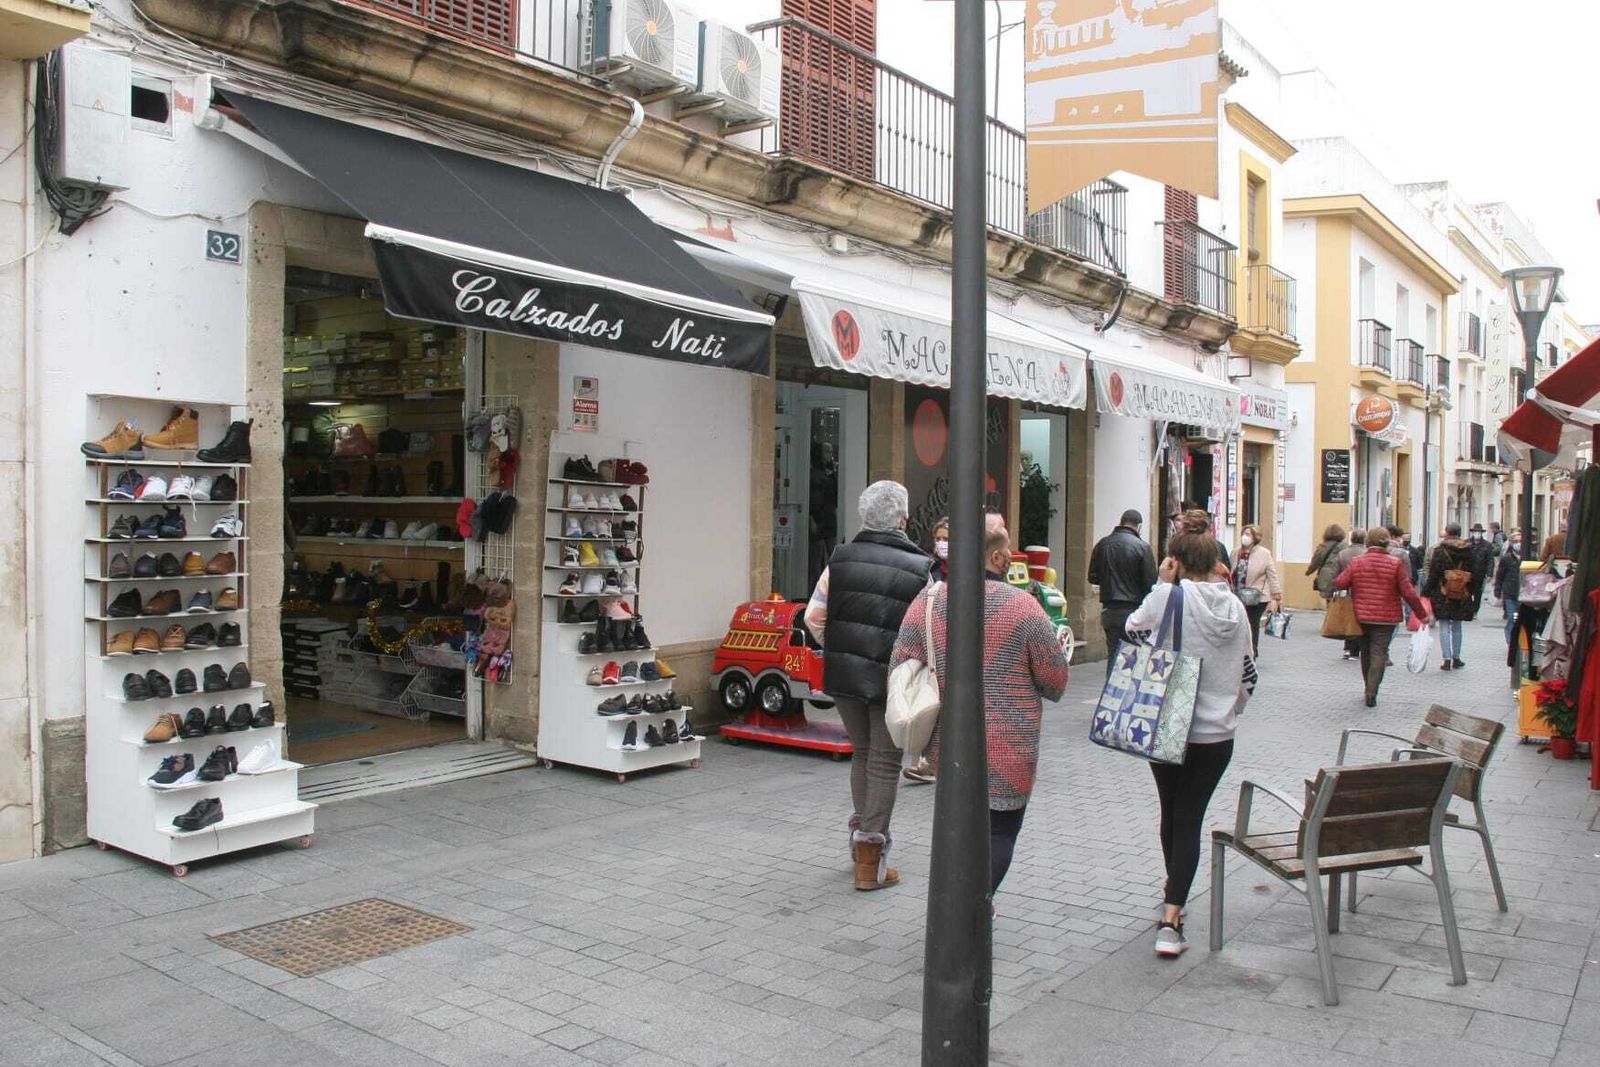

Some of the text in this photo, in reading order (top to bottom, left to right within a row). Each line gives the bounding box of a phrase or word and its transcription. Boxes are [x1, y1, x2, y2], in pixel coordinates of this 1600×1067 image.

[210, 235, 238, 259] 32
[452, 270, 726, 359] Calzados Nati
[881, 330, 1039, 393] MACENA
[1133, 383, 1214, 419] MACARENA
[785, 654, 800, 672] 24
